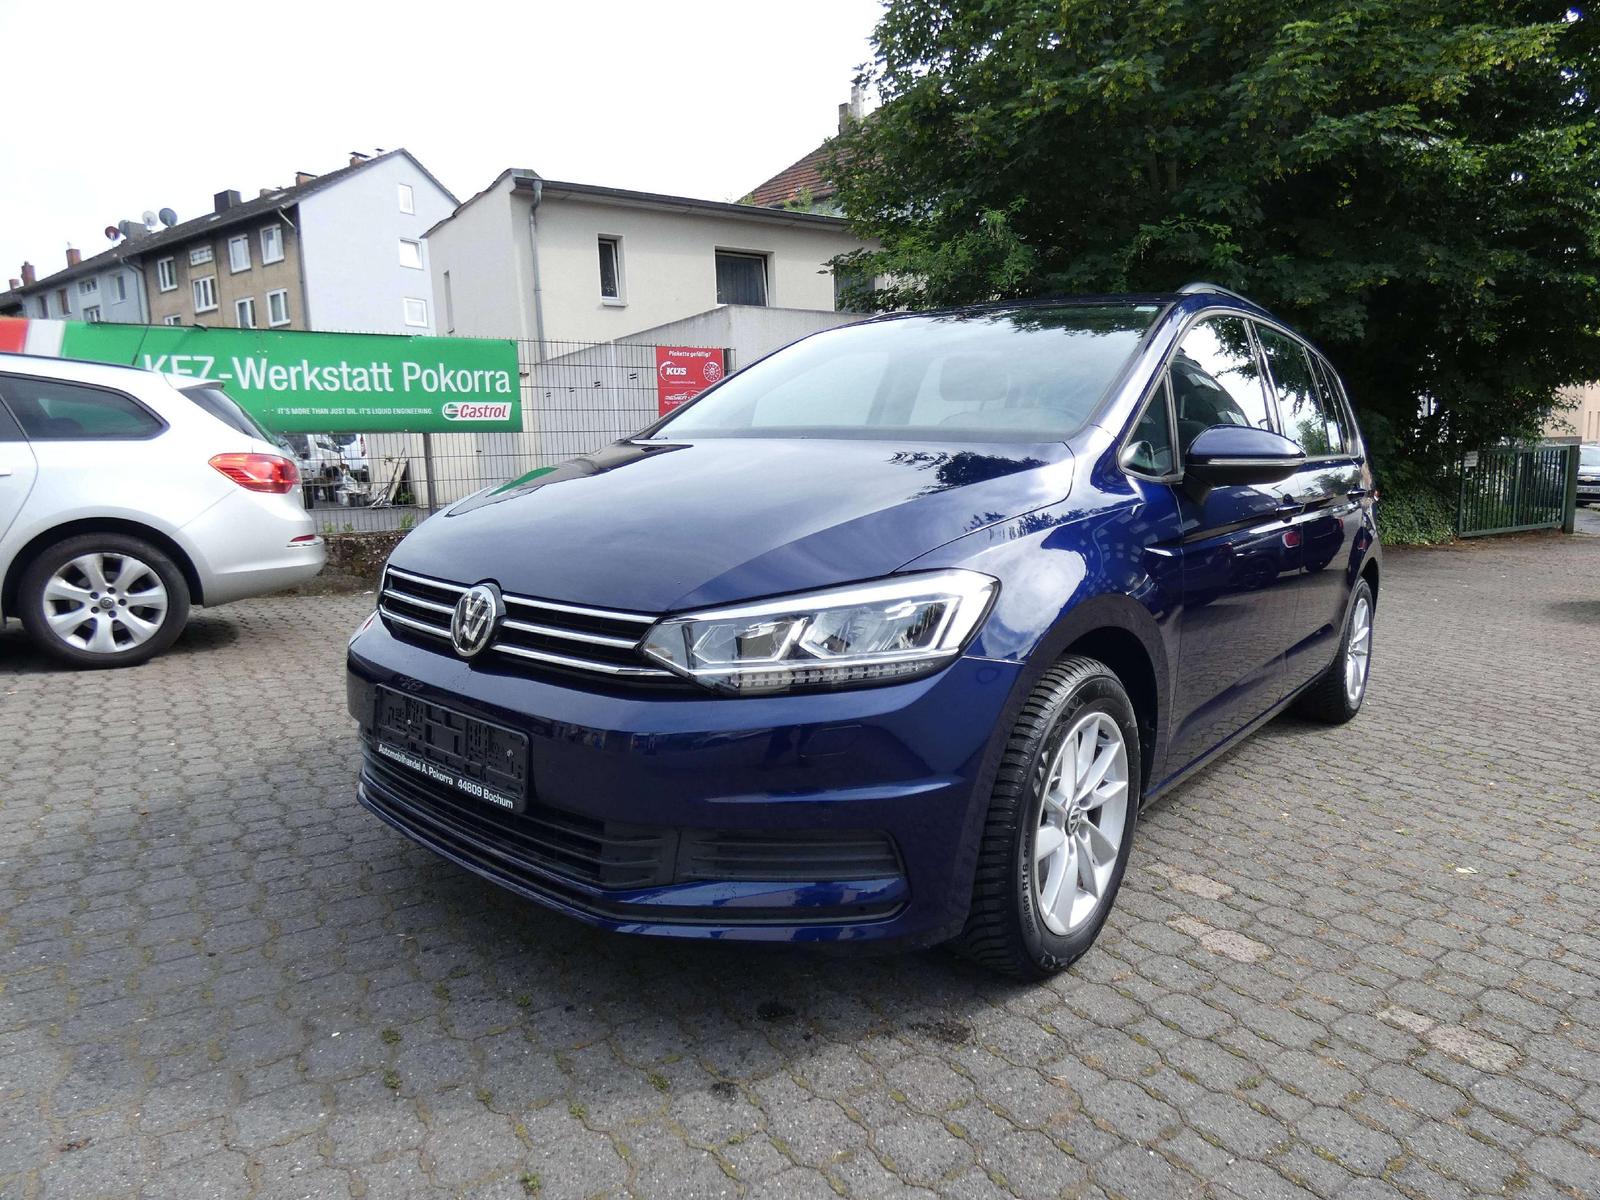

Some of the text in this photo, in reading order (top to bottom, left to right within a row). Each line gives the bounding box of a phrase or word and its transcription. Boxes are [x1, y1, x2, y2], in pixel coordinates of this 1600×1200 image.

[402, 361, 511, 393] Pokorra
[277, 407, 290, 415] IT'S
[291, 407, 310, 415] MORE
[311, 407, 329, 415] THAN
[330, 407, 345, 415] JUST
[372, 407, 392, 415] LIQUID
[460, 404, 507, 418] Castrol
[378, 743, 421, 771] Automobilhandel
[428, 766, 454, 786] Pokorra
[457, 779, 483, 797] 44809
[483, 788, 514, 809] Bochum
